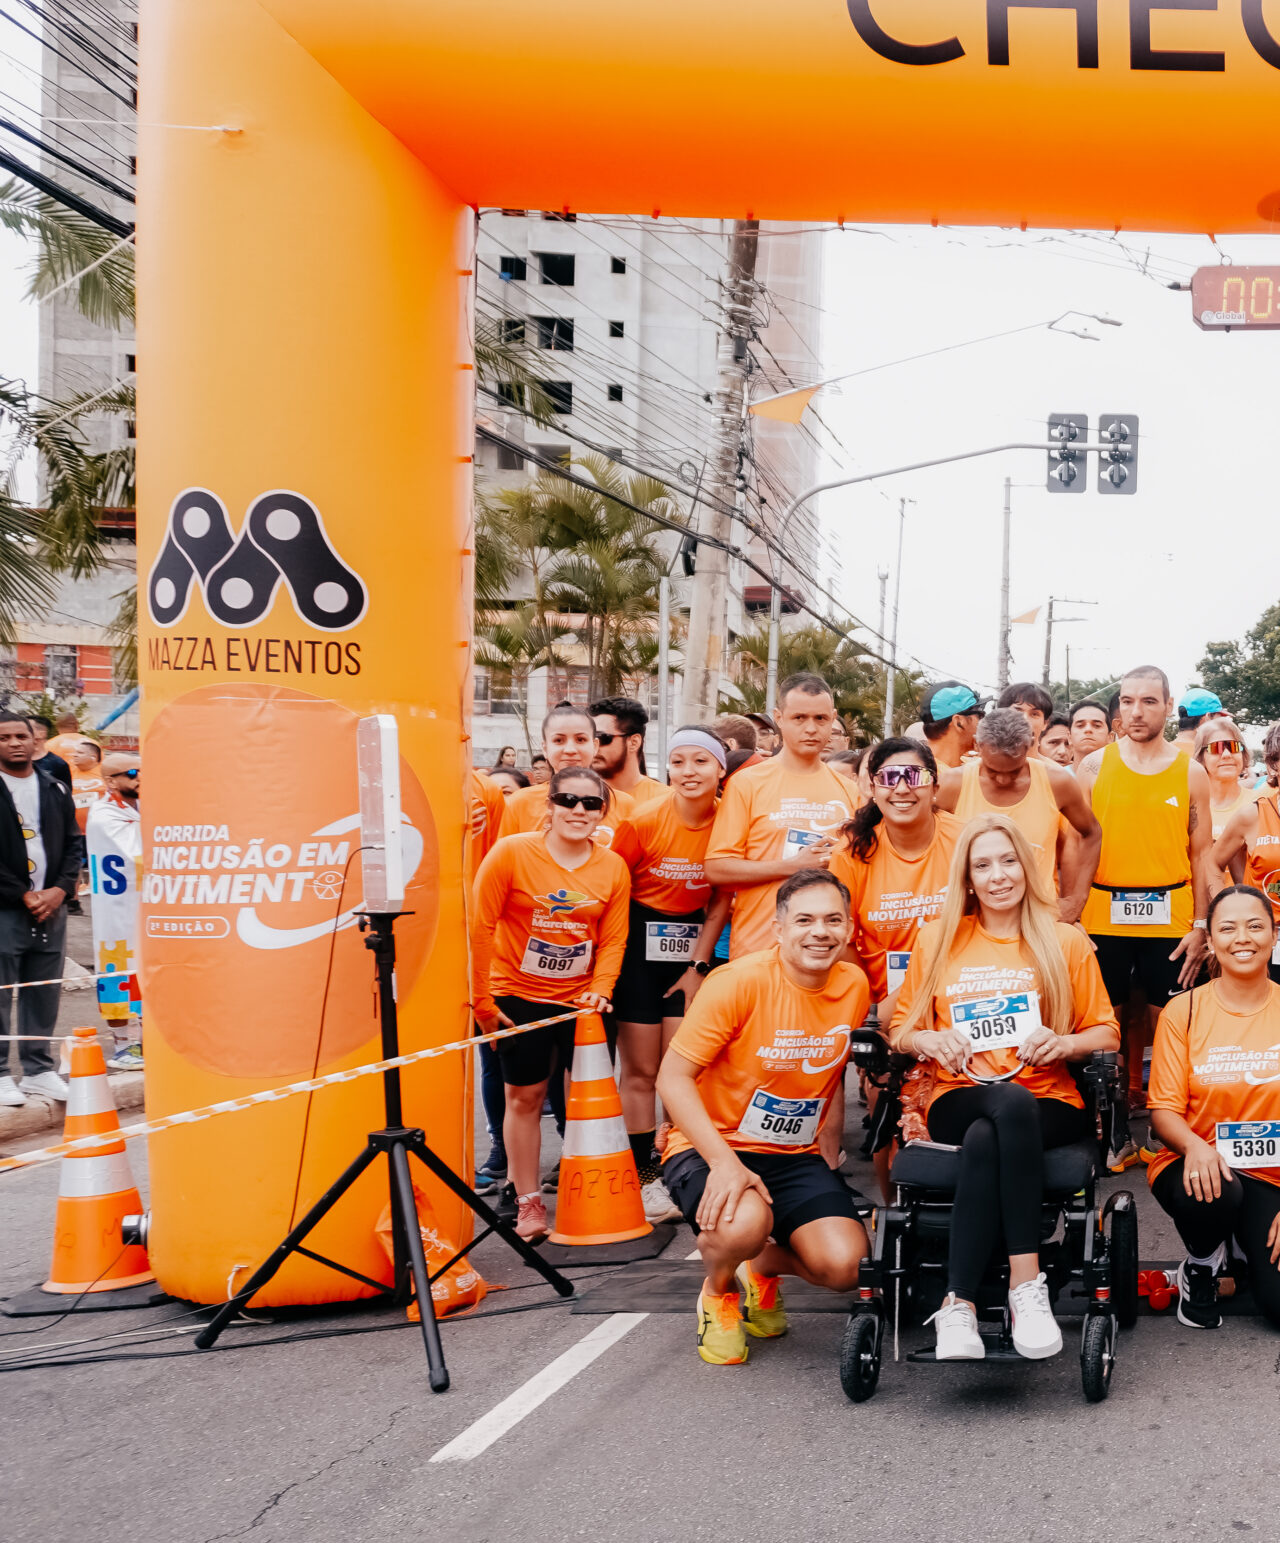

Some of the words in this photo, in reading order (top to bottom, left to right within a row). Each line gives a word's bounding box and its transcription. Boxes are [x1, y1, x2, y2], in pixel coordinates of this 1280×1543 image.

[1215, 311, 1245, 320] Global
[149, 637, 217, 671] MAZZA
[226, 638, 361, 675] EVENTOS
[153, 824, 229, 842] CORRIDA
[152, 838, 292, 869] INCLUSÃO
[297, 841, 350, 867] EM
[648, 867, 705, 880] MOVIMENT
[880, 895, 932, 910] INCLUSÃO
[1124, 902, 1153, 916] 6120
[163, 920, 215, 934] EDIÇÃO
[531, 919, 588, 930] Maratona
[660, 938, 690, 953] 6096
[538, 956, 574, 971] 6097
[969, 1015, 1016, 1040] 5059
[773, 1035, 821, 1047] INCLUSÃO
[1207, 1050, 1263, 1063] INCLUSÃO
[760, 1114, 804, 1135] 5046
[1233, 1139, 1276, 1157] 5330
